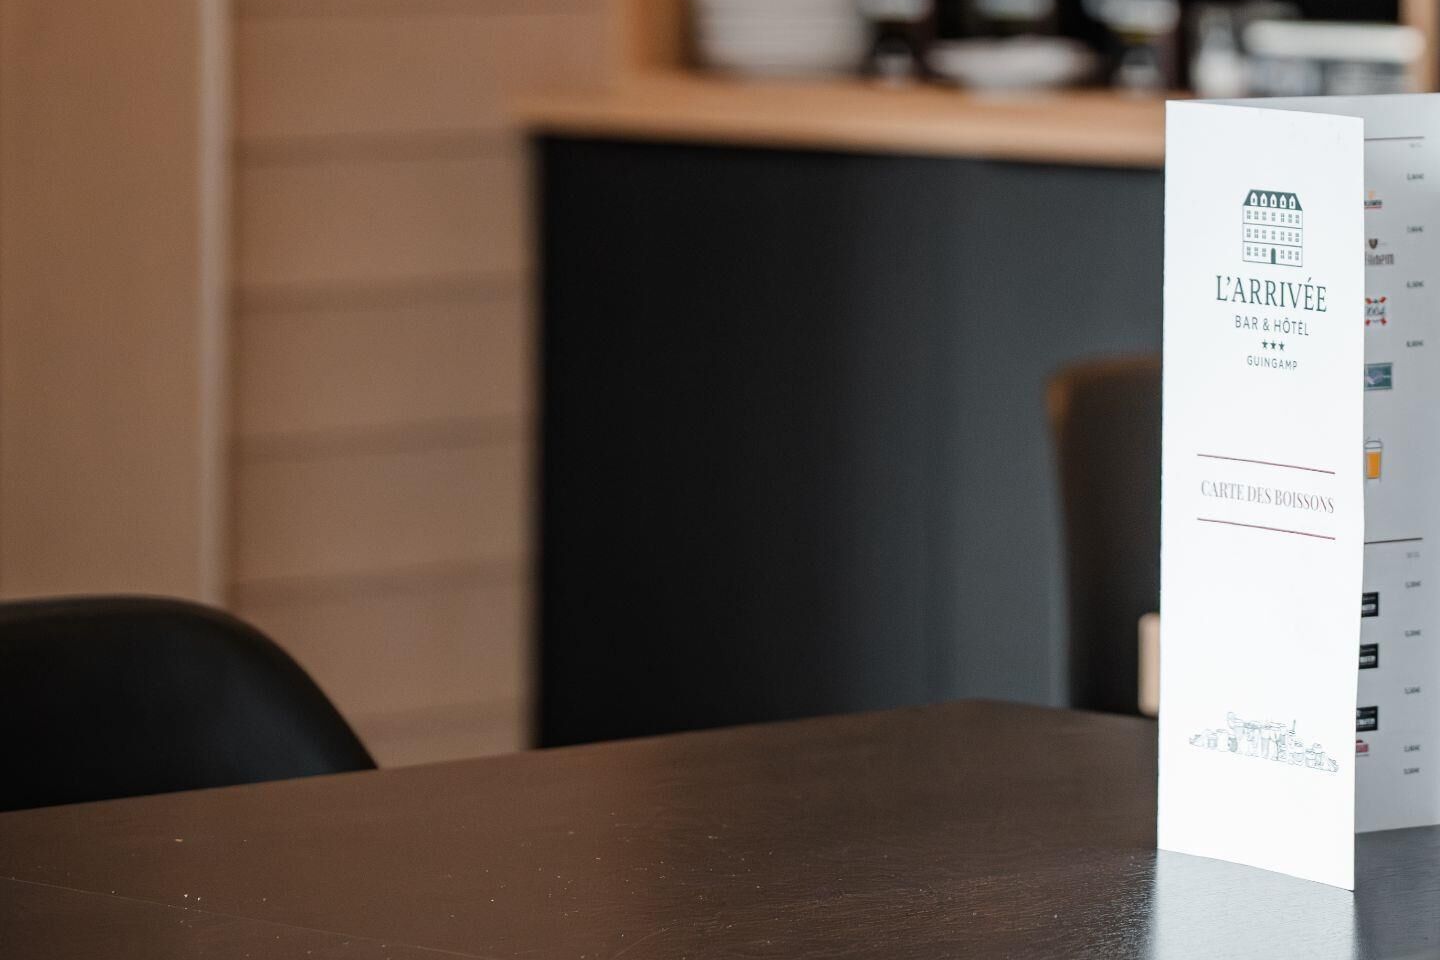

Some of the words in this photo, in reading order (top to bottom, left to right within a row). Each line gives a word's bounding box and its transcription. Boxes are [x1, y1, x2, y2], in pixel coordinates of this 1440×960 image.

[1235, 315, 1258, 330] BAR
[1263, 318, 1270, 331] &
[1274, 317, 1309, 336] HÔTEL
[1246, 355, 1298, 371] GUINGAMP
[1200, 479, 1245, 501] CARTE
[1247, 485, 1272, 505] DES
[1274, 489, 1335, 515] BOISSONS
